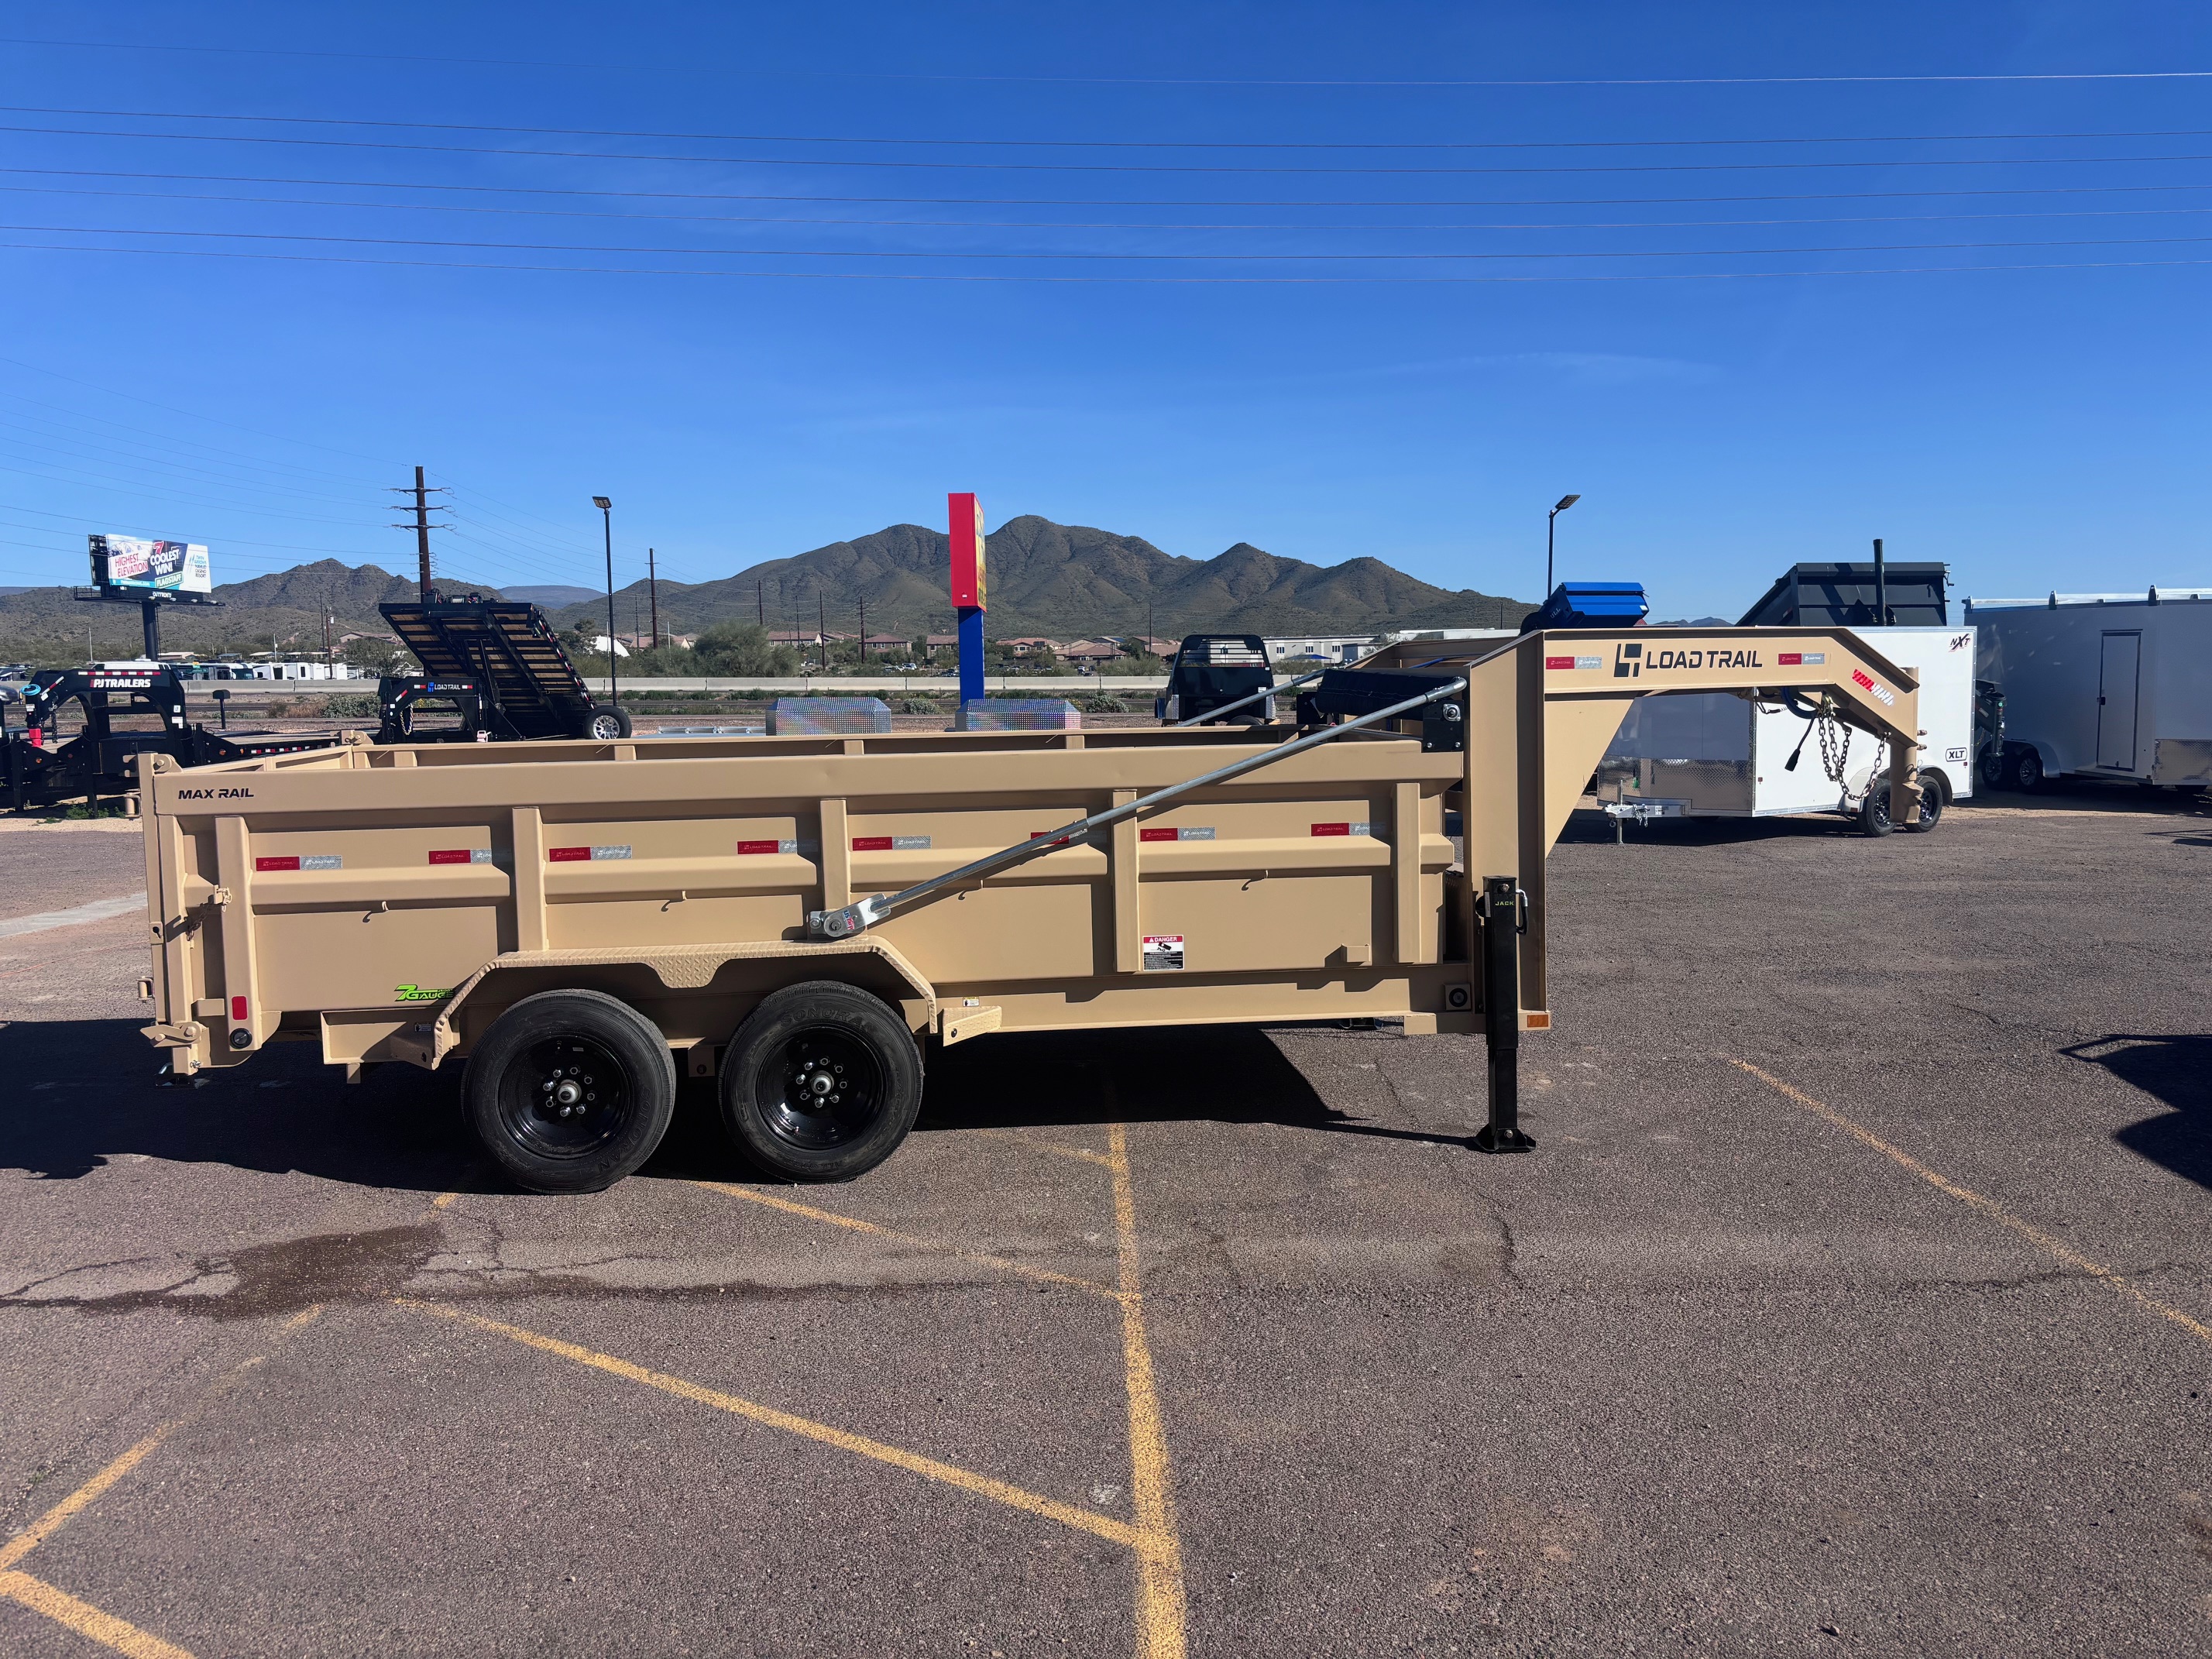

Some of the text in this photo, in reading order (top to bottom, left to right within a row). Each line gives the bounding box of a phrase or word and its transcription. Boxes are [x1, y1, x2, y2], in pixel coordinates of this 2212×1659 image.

[153, 541, 164, 555] 7
[115, 553, 139, 568] HIGHEST
[149, 549, 180, 566] COOLEST
[117, 561, 149, 578] ELEVATION
[155, 562, 173, 575] WIN!
[156, 574, 183, 588] FLAGSTAFF
[1949, 634, 1970, 651] NXT
[1646, 650, 1763, 669] LOAD TRAIL
[94, 678, 151, 688] PJ TRAILERS
[1949, 750, 1965, 759] XLT
[178, 788, 254, 799] MAX RAIL
[394, 984, 454, 1001] 7 GAUGE
